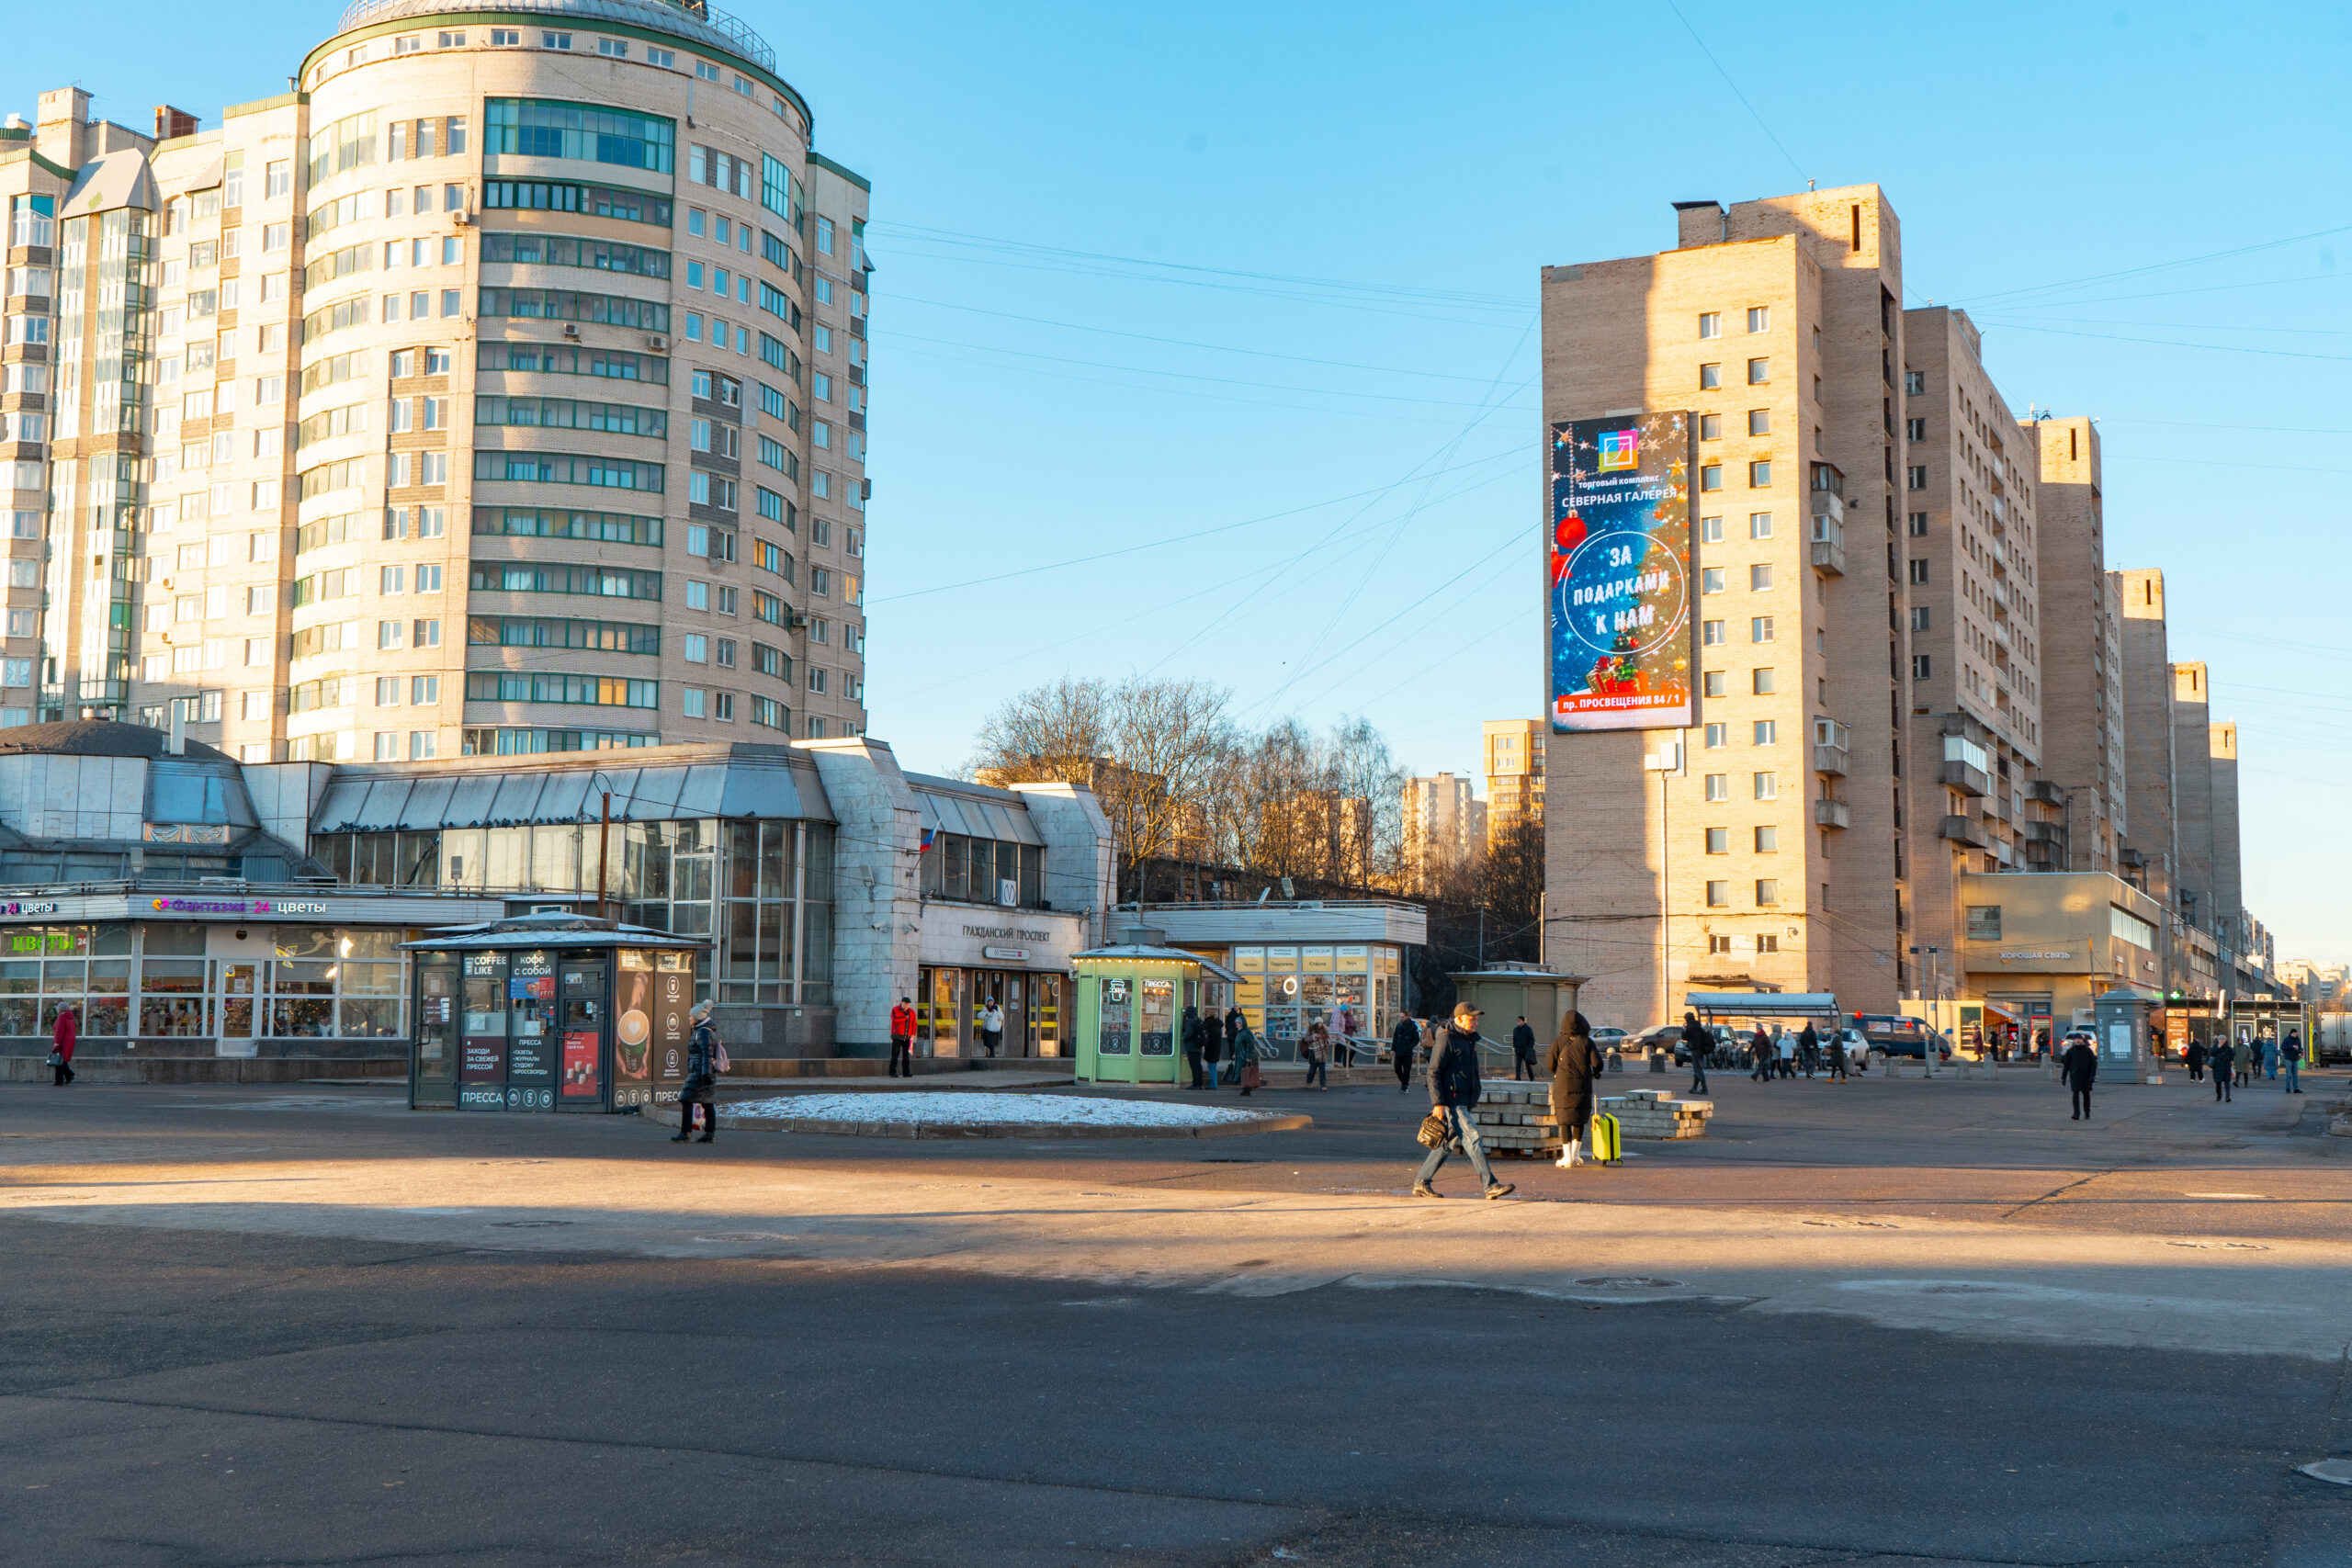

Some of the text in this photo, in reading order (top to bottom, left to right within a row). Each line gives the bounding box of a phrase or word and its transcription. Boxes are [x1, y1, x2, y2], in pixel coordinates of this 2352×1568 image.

[1578, 475, 1659, 491] торговый комплекс
[1562, 487, 1677, 507] СЕВЕРНАЯ ГАЛЕРЕЯ
[1610, 545, 1633, 567] ЗА
[1574, 570, 1669, 606] ПОДАРКАМИ
[1596, 604, 1654, 635] К НАМ
[1563, 701, 1577, 711] пр.
[1579, 695, 1653, 709] ПРОСВЕЩЕНИЯ
[1654, 694, 1666, 704] 84
[1674, 694, 1679, 704] 1
[7, 902, 18, 914] 24
[21, 903, 54, 915] цветы
[172, 899, 327, 914] Фантазия 24 цветы
[962, 925, 1050, 942] ГРАЖДАНСКИЙ ПРОСПЕКТ
[474, 956, 507, 965] COFFEE
[520, 954, 545, 966] кофе
[474, 965, 493, 975] LIKE
[514, 964, 551, 976] с собой
[466, 1062, 493, 1070] ПРЕССОЙ
[461, 1091, 503, 1103] ПРЕССА
[655, 1090, 682, 1102] ПРЕС
